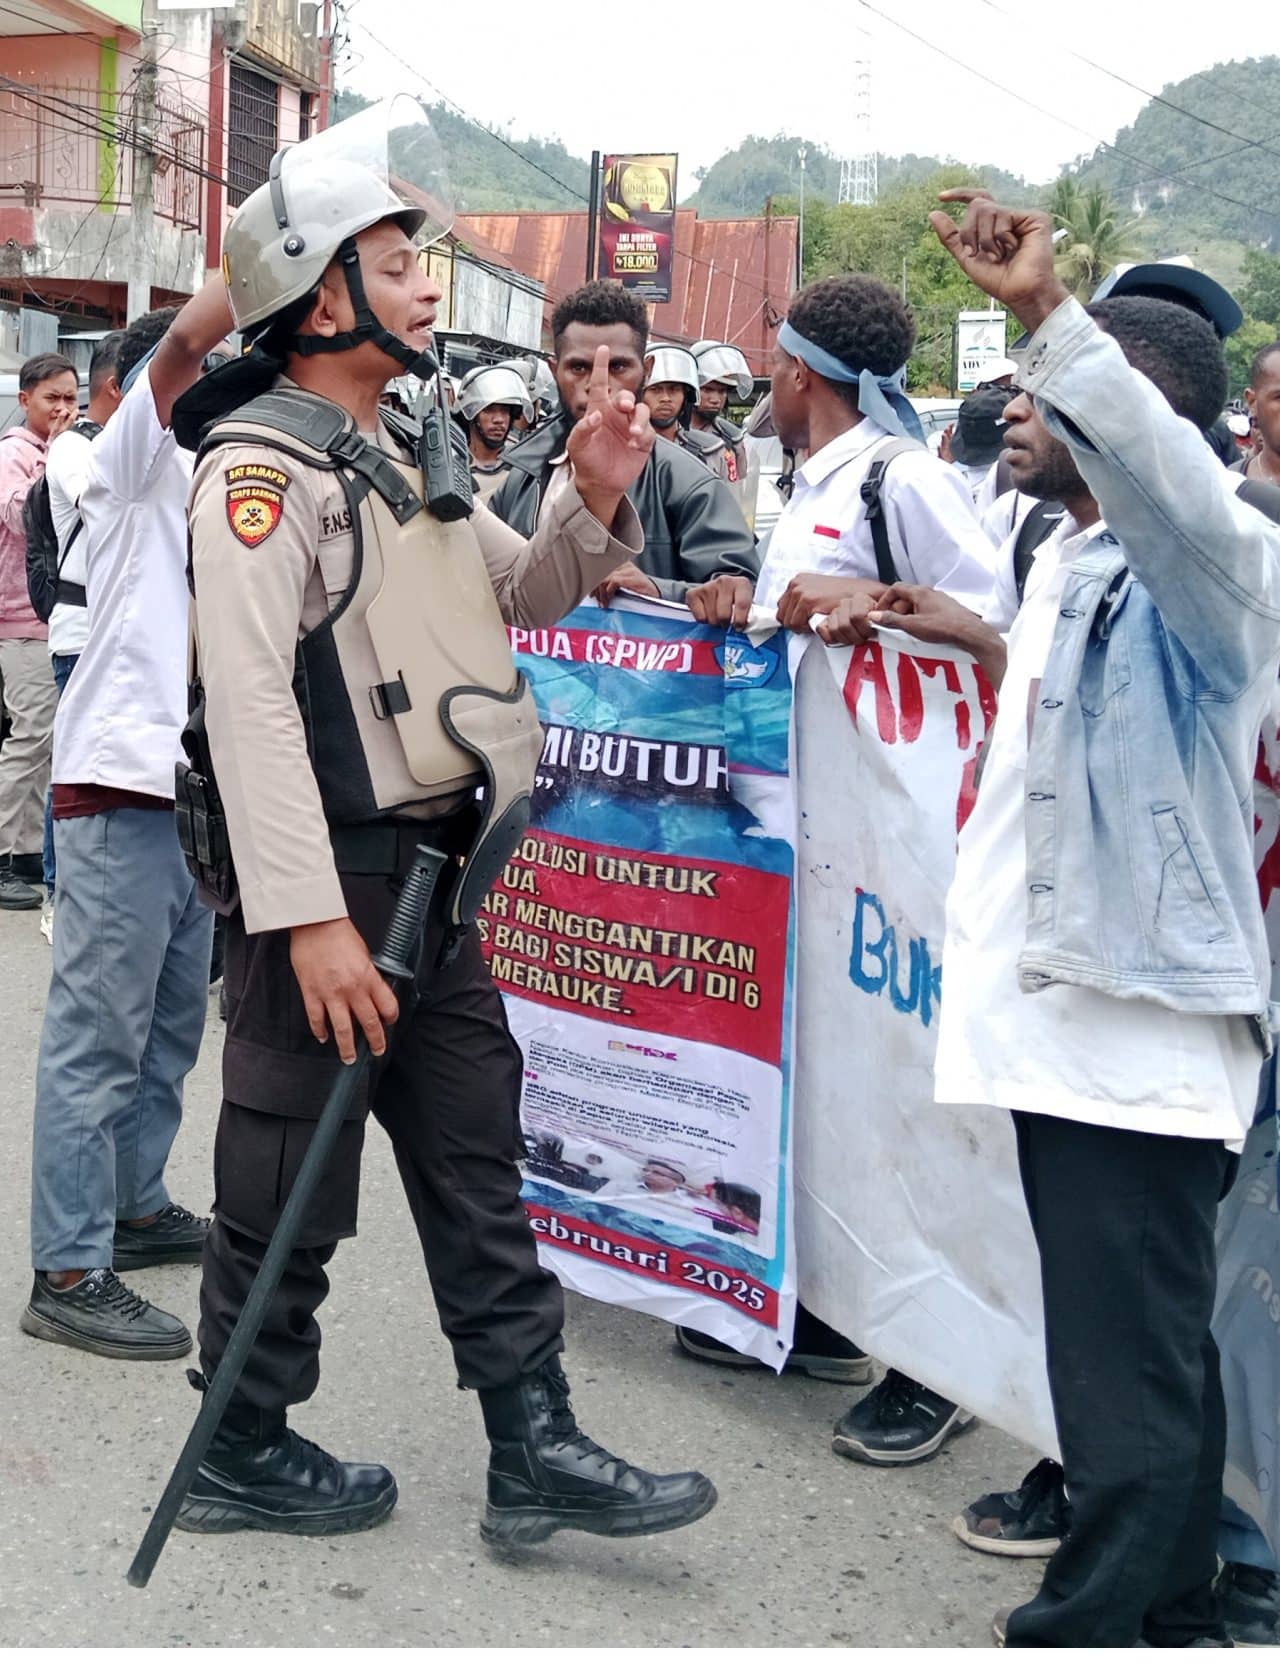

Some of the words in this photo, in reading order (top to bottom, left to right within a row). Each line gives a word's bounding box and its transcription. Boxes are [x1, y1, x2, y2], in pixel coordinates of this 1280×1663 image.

[229, 468, 244, 479] SAT
[245, 466, 287, 485] SAMAPTA
[585, 635, 693, 673] (SPWP)
[579, 733, 729, 792] BUTUH
[512, 838, 586, 876] OLUSI
[595, 855, 718, 897] UNTUK
[515, 898, 755, 973] MENGGANTIKAN
[495, 923, 549, 962] BAGI
[554, 942, 695, 993] SISWA/I
[705, 971, 738, 1003] DI
[744, 981, 761, 1010] 6
[524, 1209, 668, 1274] ebruari
[681, 1260, 766, 1311] 2025
